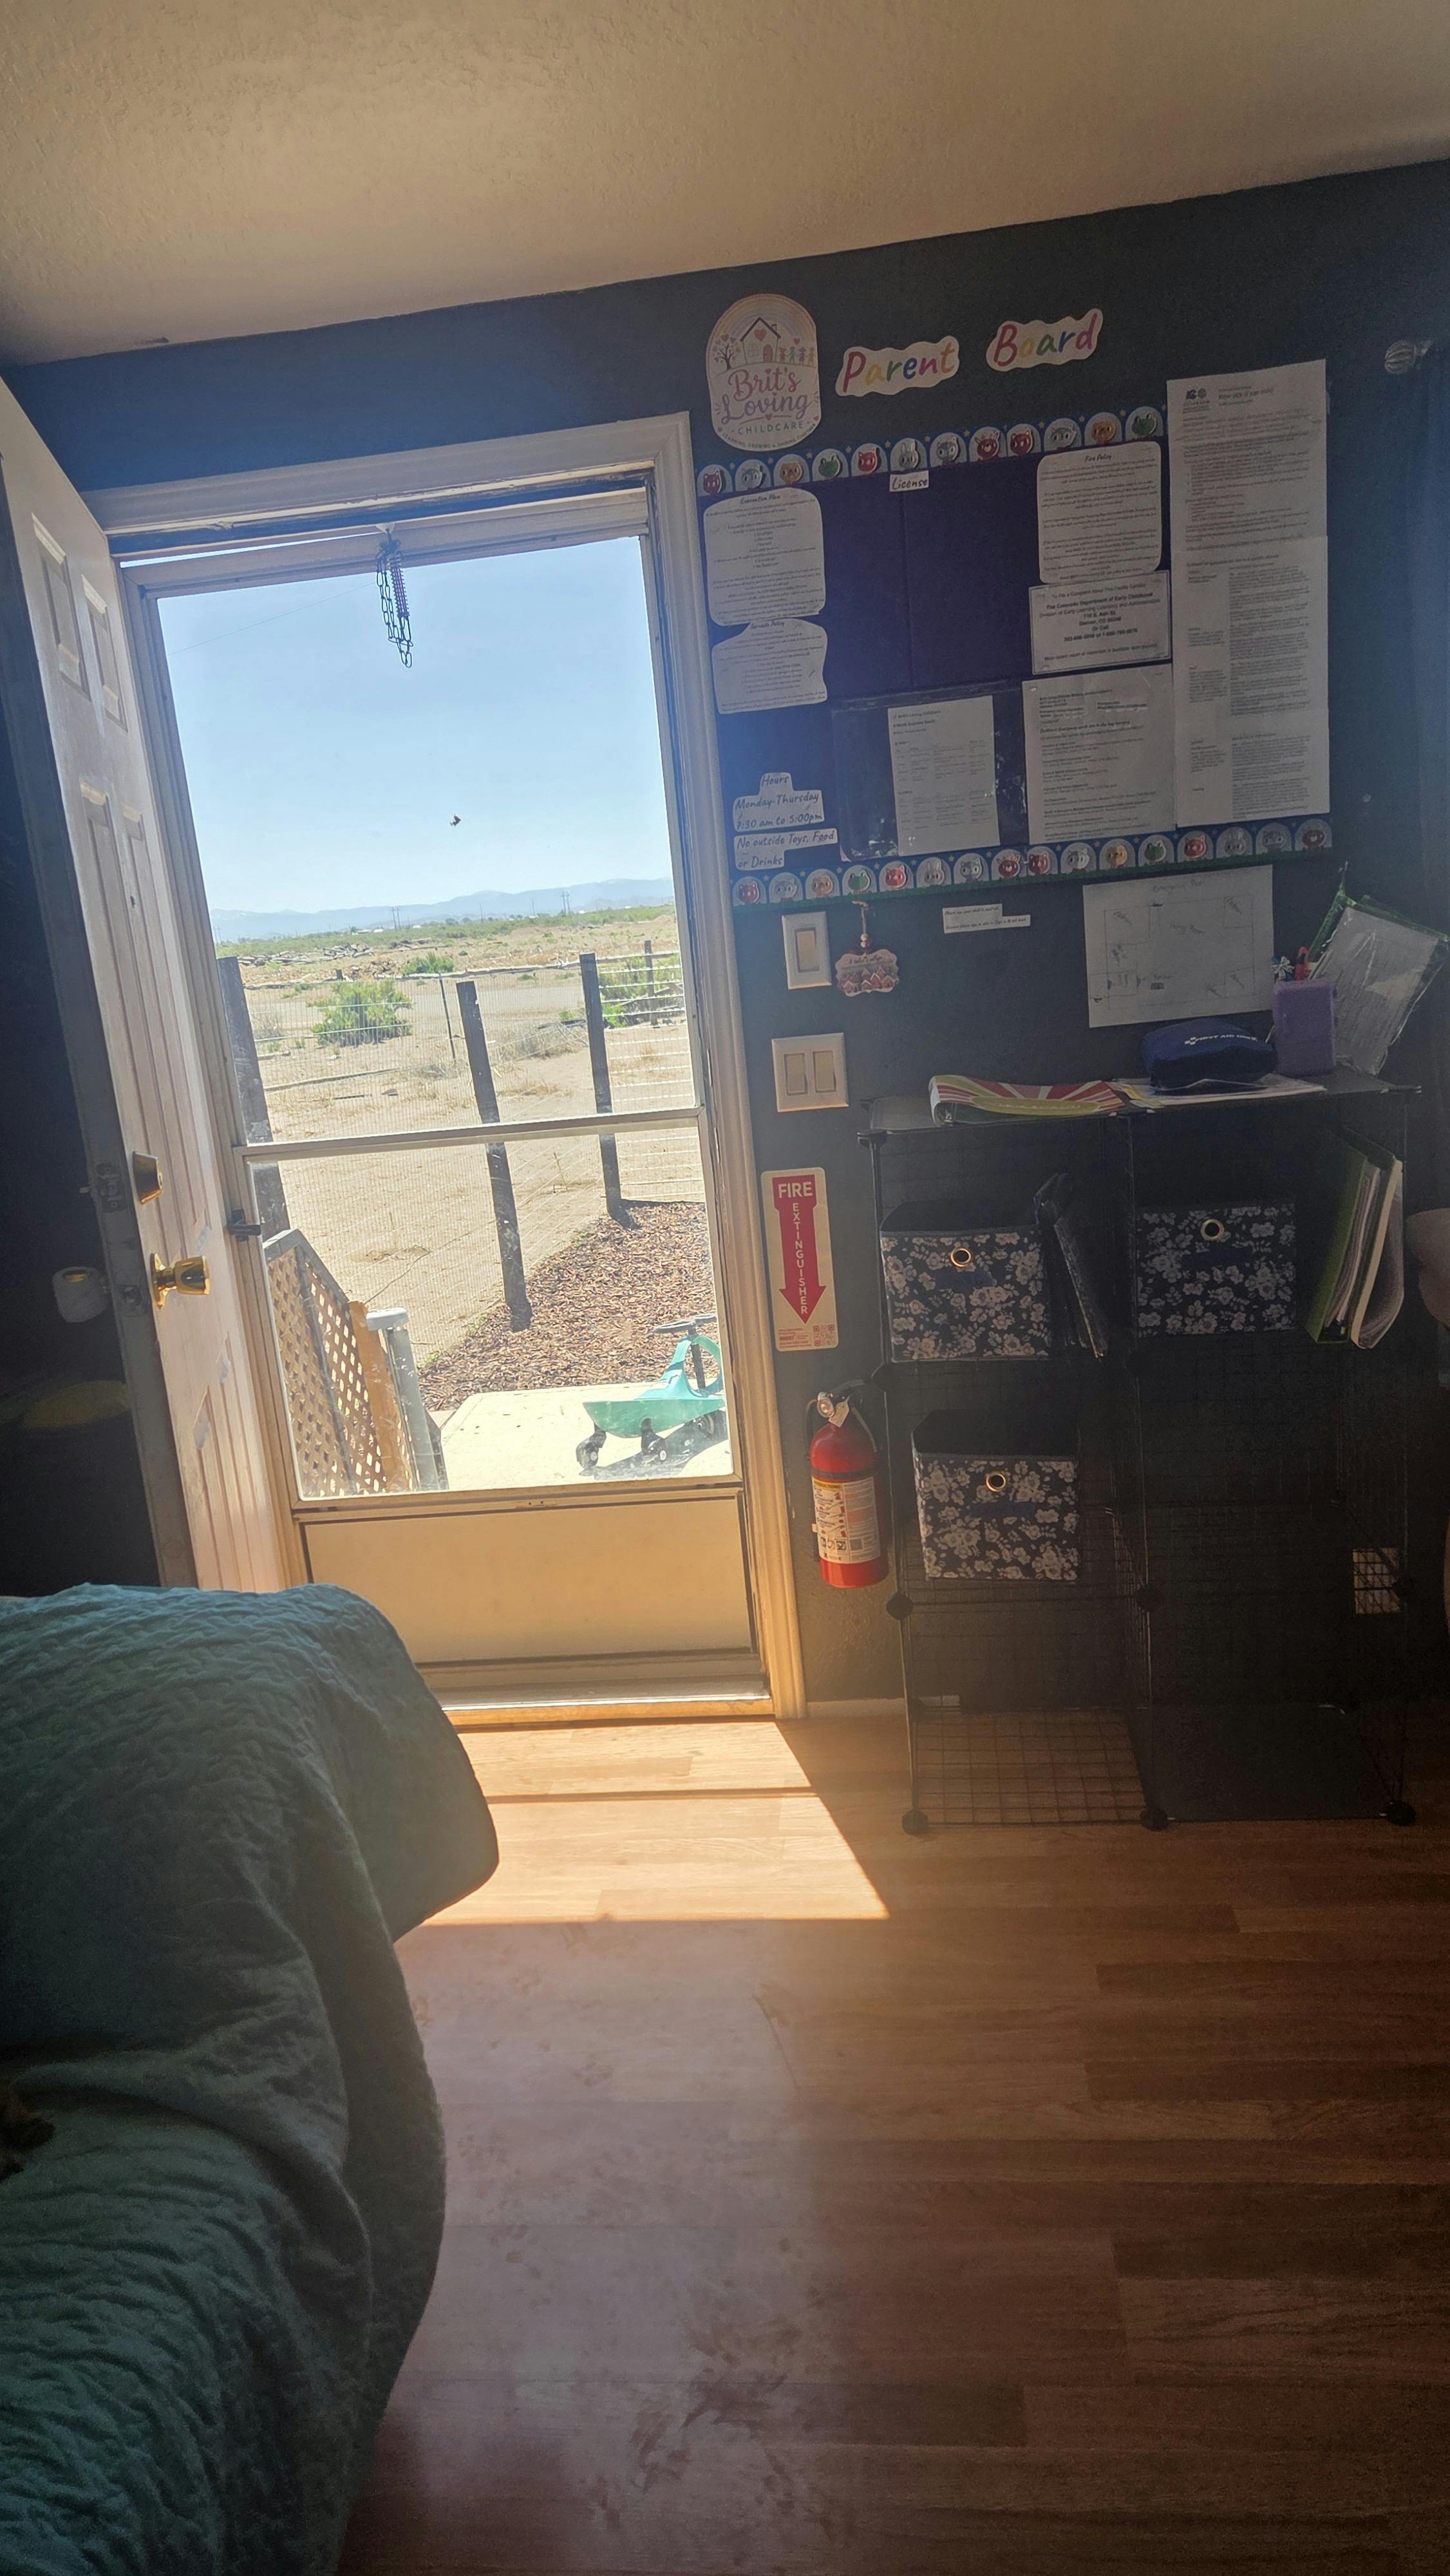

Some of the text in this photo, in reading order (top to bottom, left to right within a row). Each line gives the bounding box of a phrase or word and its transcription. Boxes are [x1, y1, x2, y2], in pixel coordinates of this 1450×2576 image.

[843, 314, 1097, 392] Parent Board
[728, 367, 802, 401] Brit's
[721, 393, 812, 424] Loving
[738, 421, 804, 435] CHILDCARE
[892, 478, 927, 490] License
[761, 775, 789, 788] Hours
[737, 819, 756, 830] 7:30
[776, 815, 785, 824] to
[789, 813, 822, 824] 5:00pm
[737, 838, 749, 849] No
[753, 836, 784, 846] outside
[813, 831, 834, 842] Food
[751, 856, 782, 868] Drinks
[778, 1182, 813, 1198] FIRE
[793, 1202, 807, 1314] EXTINGUISHER
